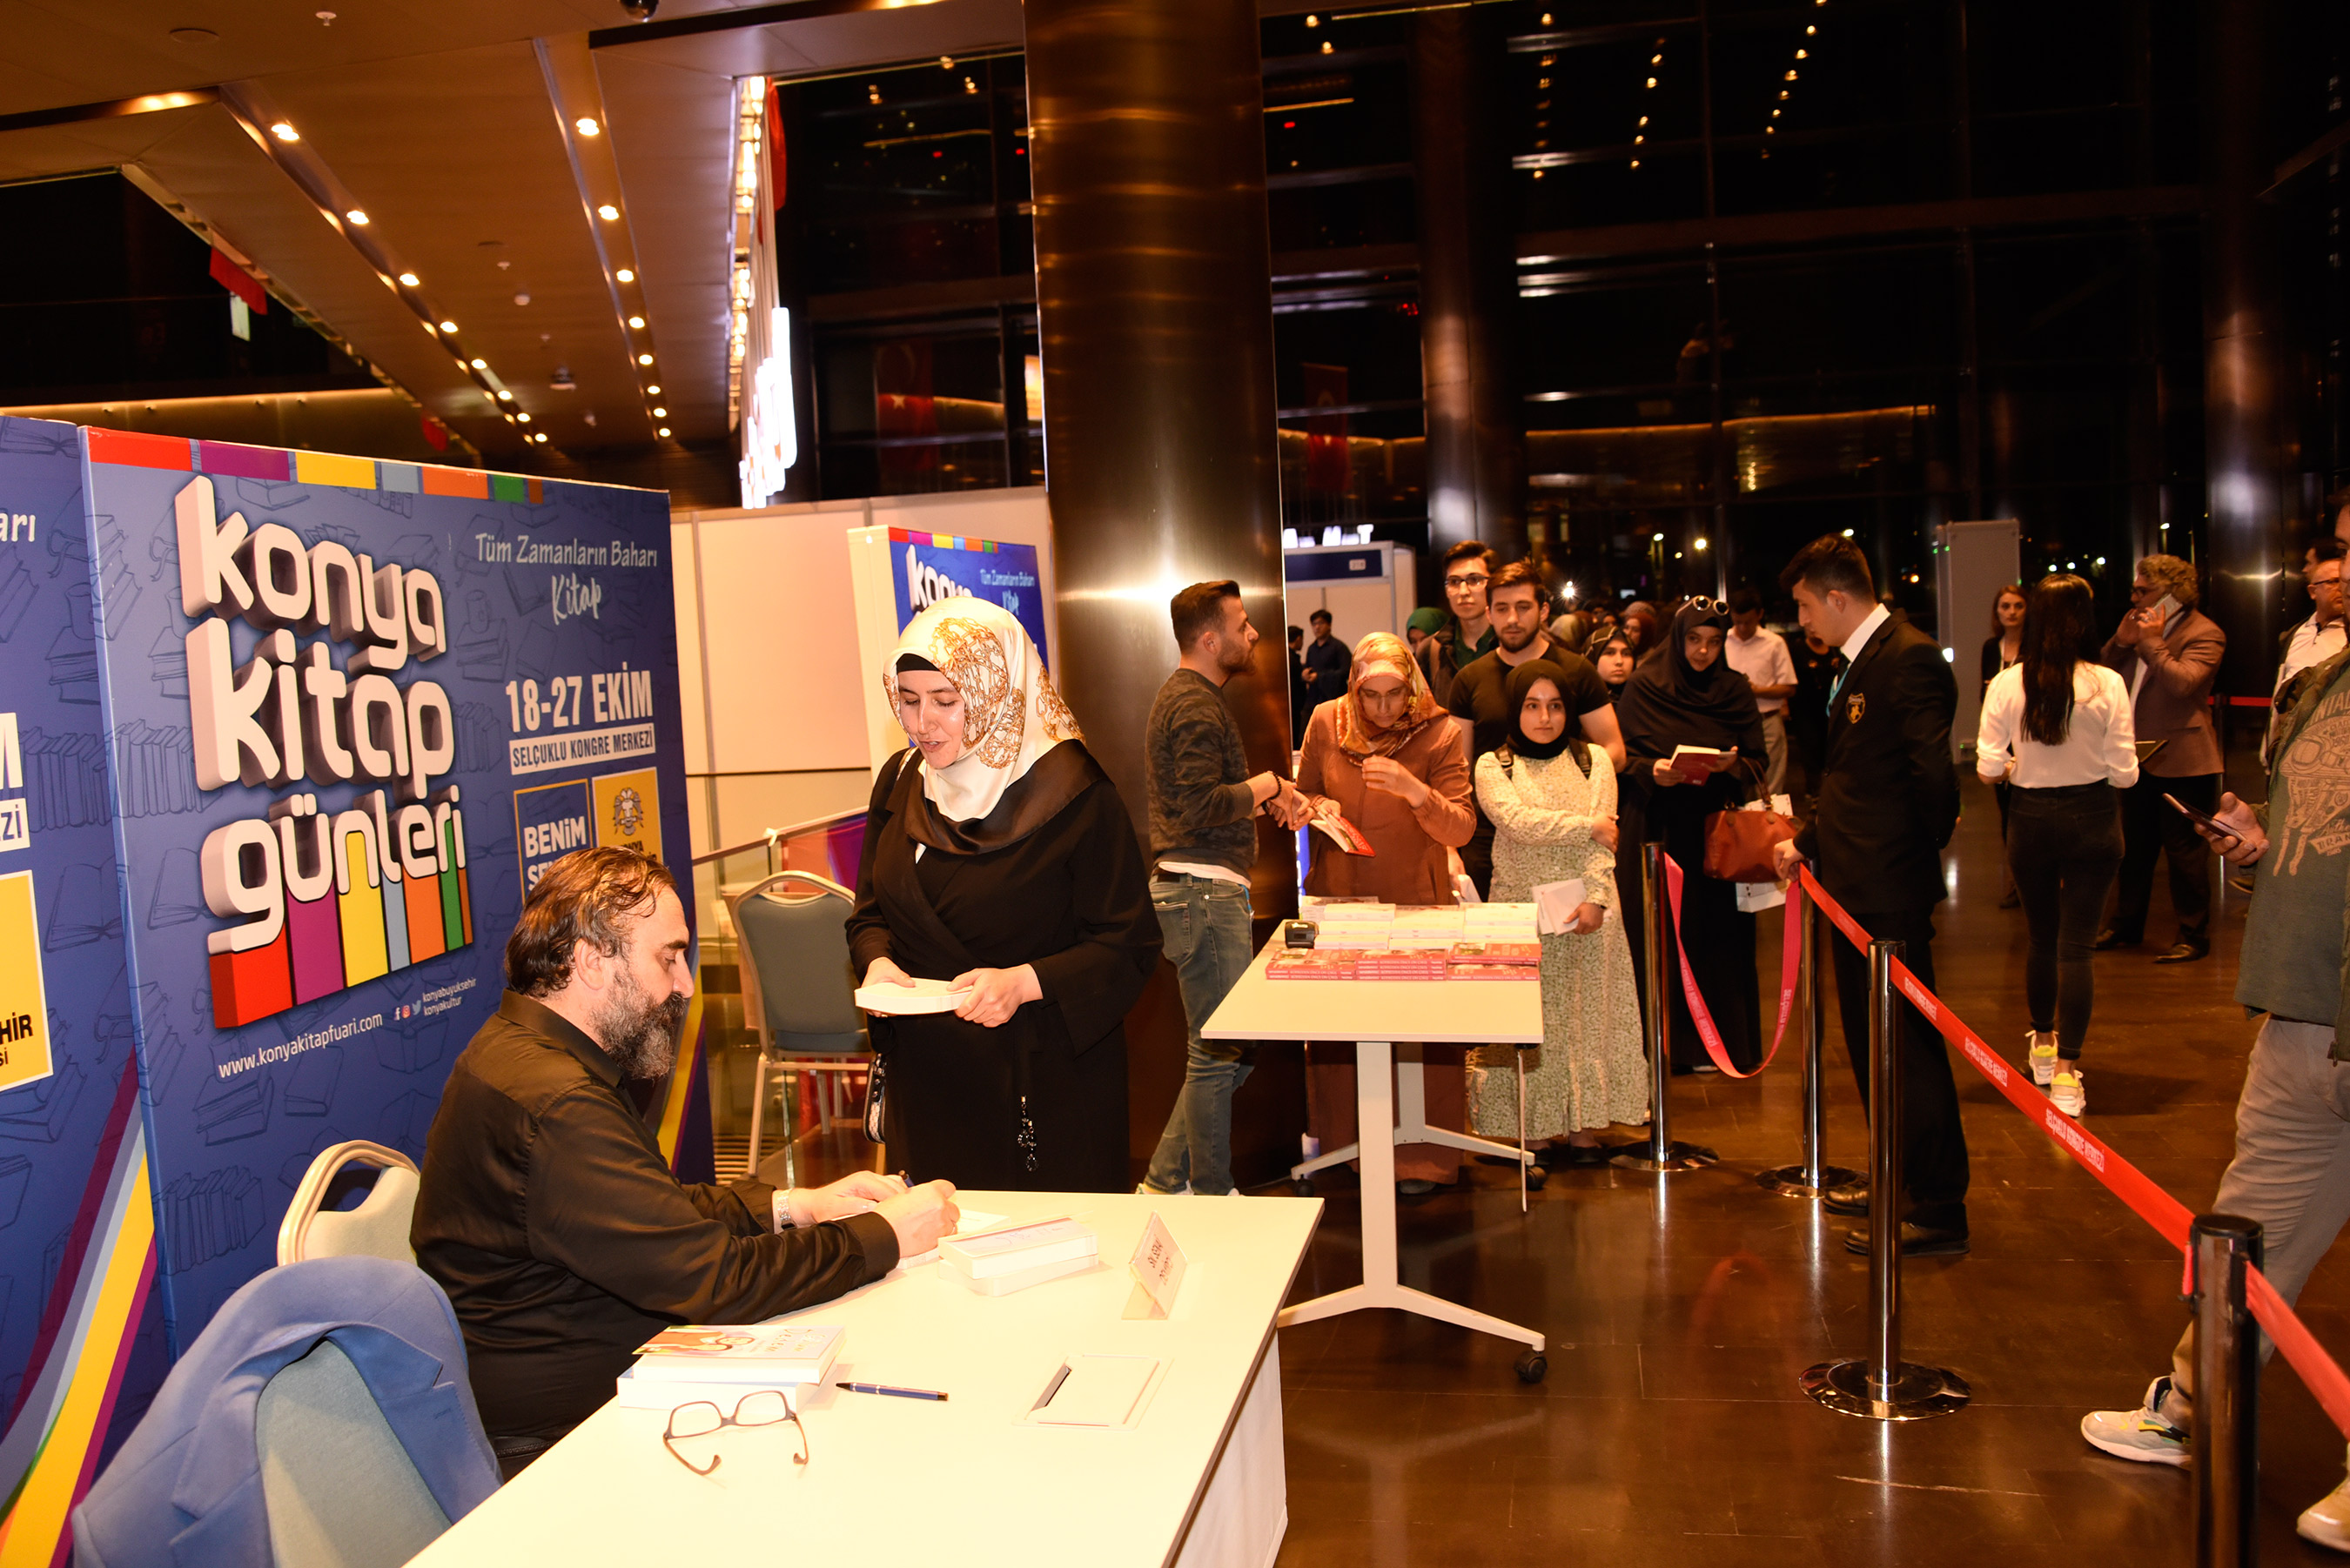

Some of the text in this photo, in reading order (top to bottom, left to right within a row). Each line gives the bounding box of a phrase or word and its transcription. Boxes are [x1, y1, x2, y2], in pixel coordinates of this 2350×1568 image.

[177, 475, 446, 671] konya
[475, 533, 657, 567] Tüm Zamanların Baharı
[551, 572, 602, 626] Kitap
[185, 617, 455, 800] kitap
[506, 661, 653, 733] 18-27 EKİM
[513, 726, 654, 767] SELÇUKLU KONGRE MERKEZİ
[0, 804, 23, 841] Zİ
[200, 784, 467, 954] günleri
[422, 977, 477, 1002] konyabuyuksehir
[423, 996, 462, 1016] konyakultur
[218, 1014, 383, 1078] www.konyakitapfuari.com
